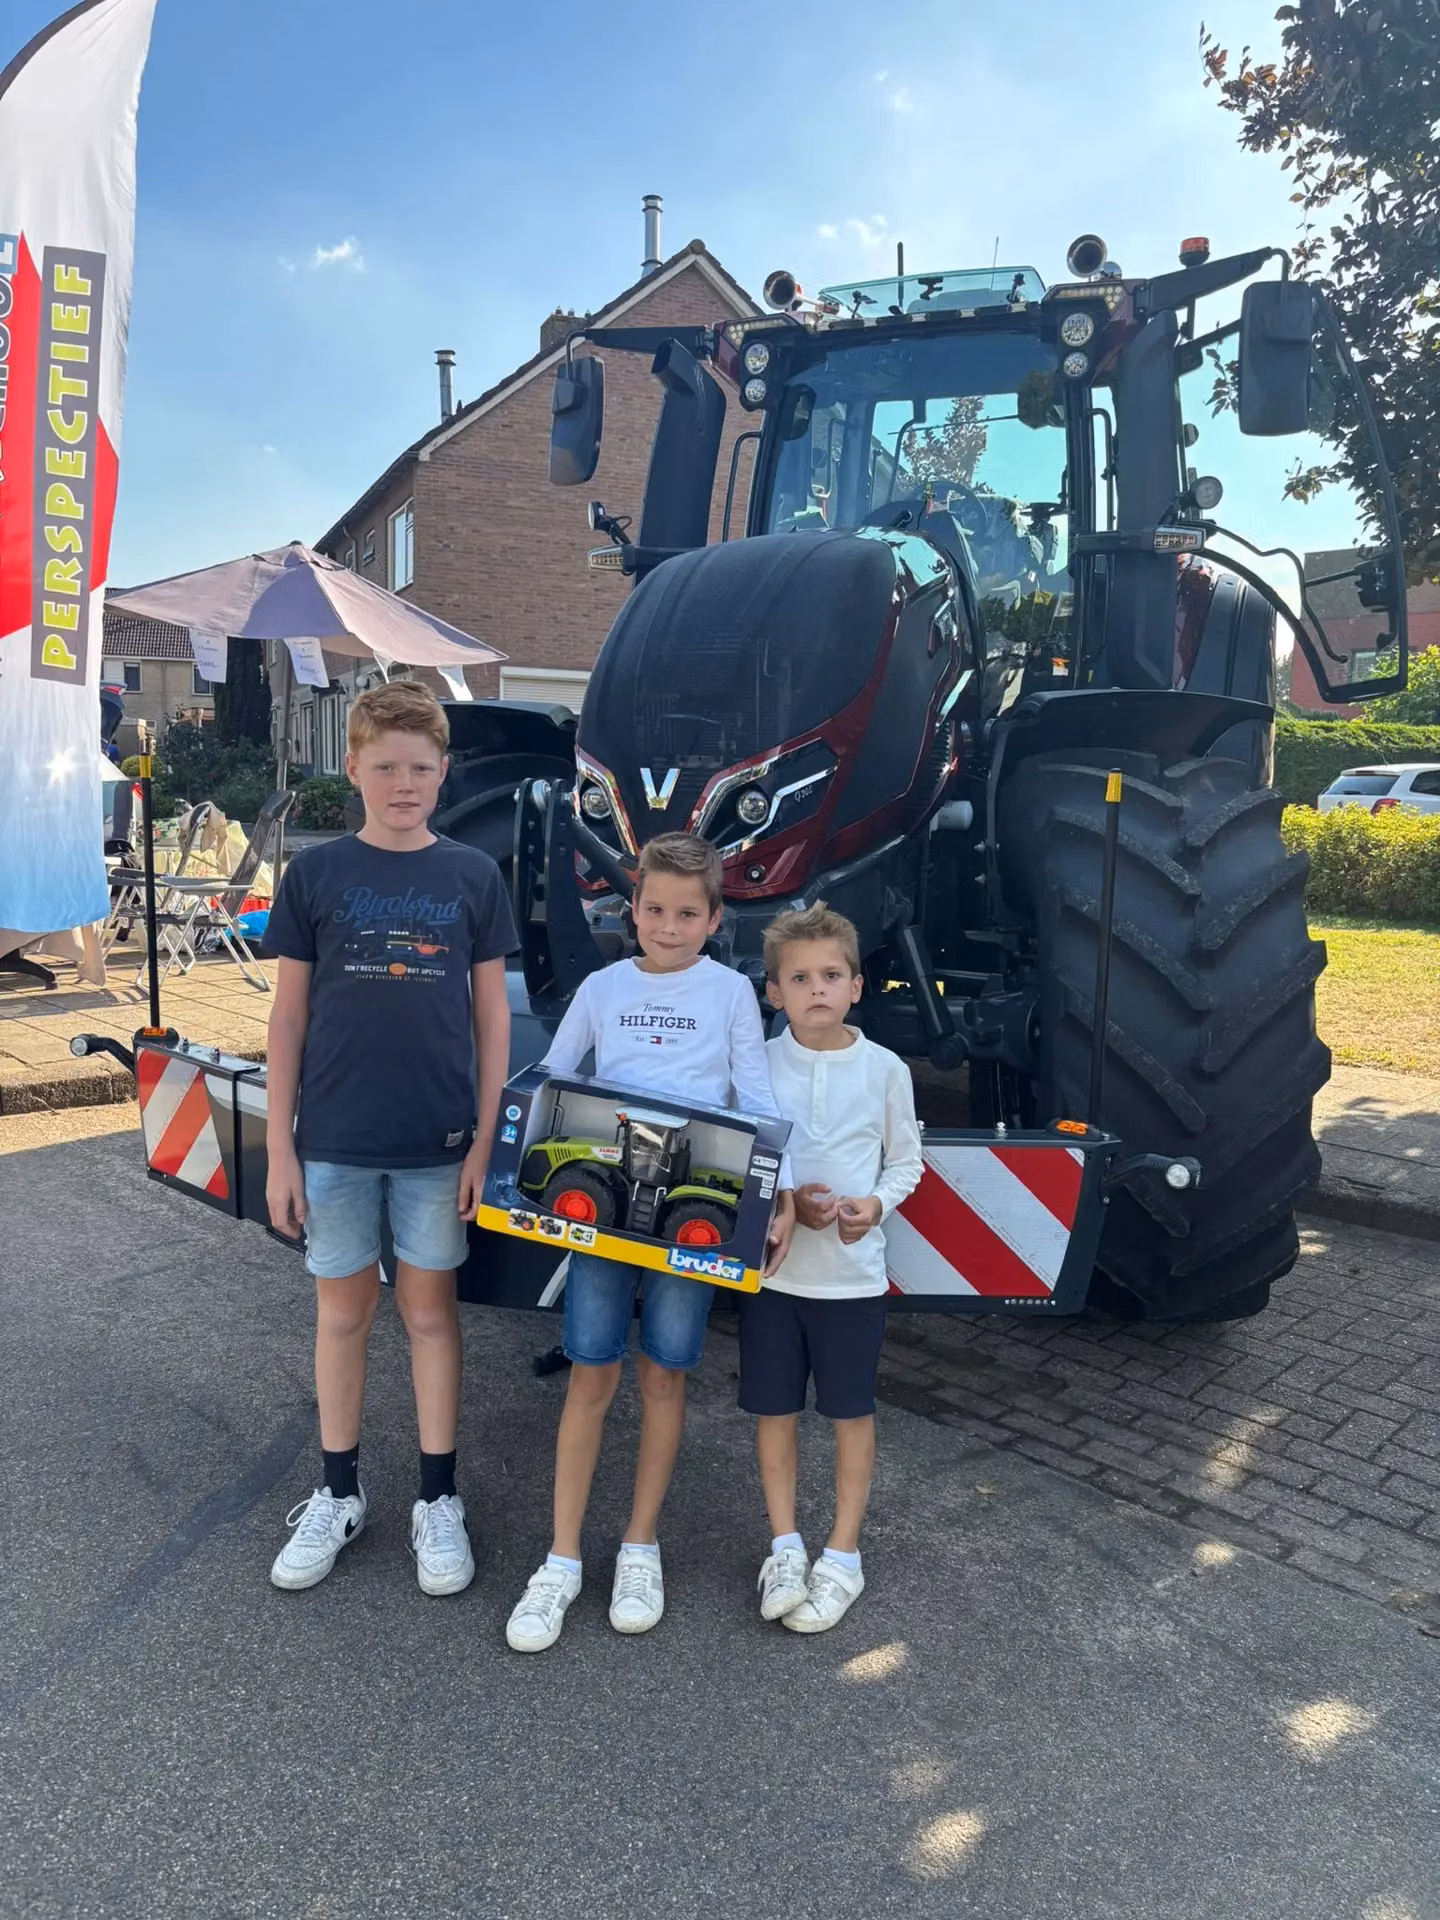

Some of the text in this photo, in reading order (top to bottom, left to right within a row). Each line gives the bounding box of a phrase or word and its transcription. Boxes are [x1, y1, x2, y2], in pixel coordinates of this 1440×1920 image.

[42, 263, 93, 670] PERSPECTIEF
[643, 1003, 676, 1015] Tommy
[619, 1015, 697, 1030] HILFIGER
[670, 1248, 742, 1280] bruder
